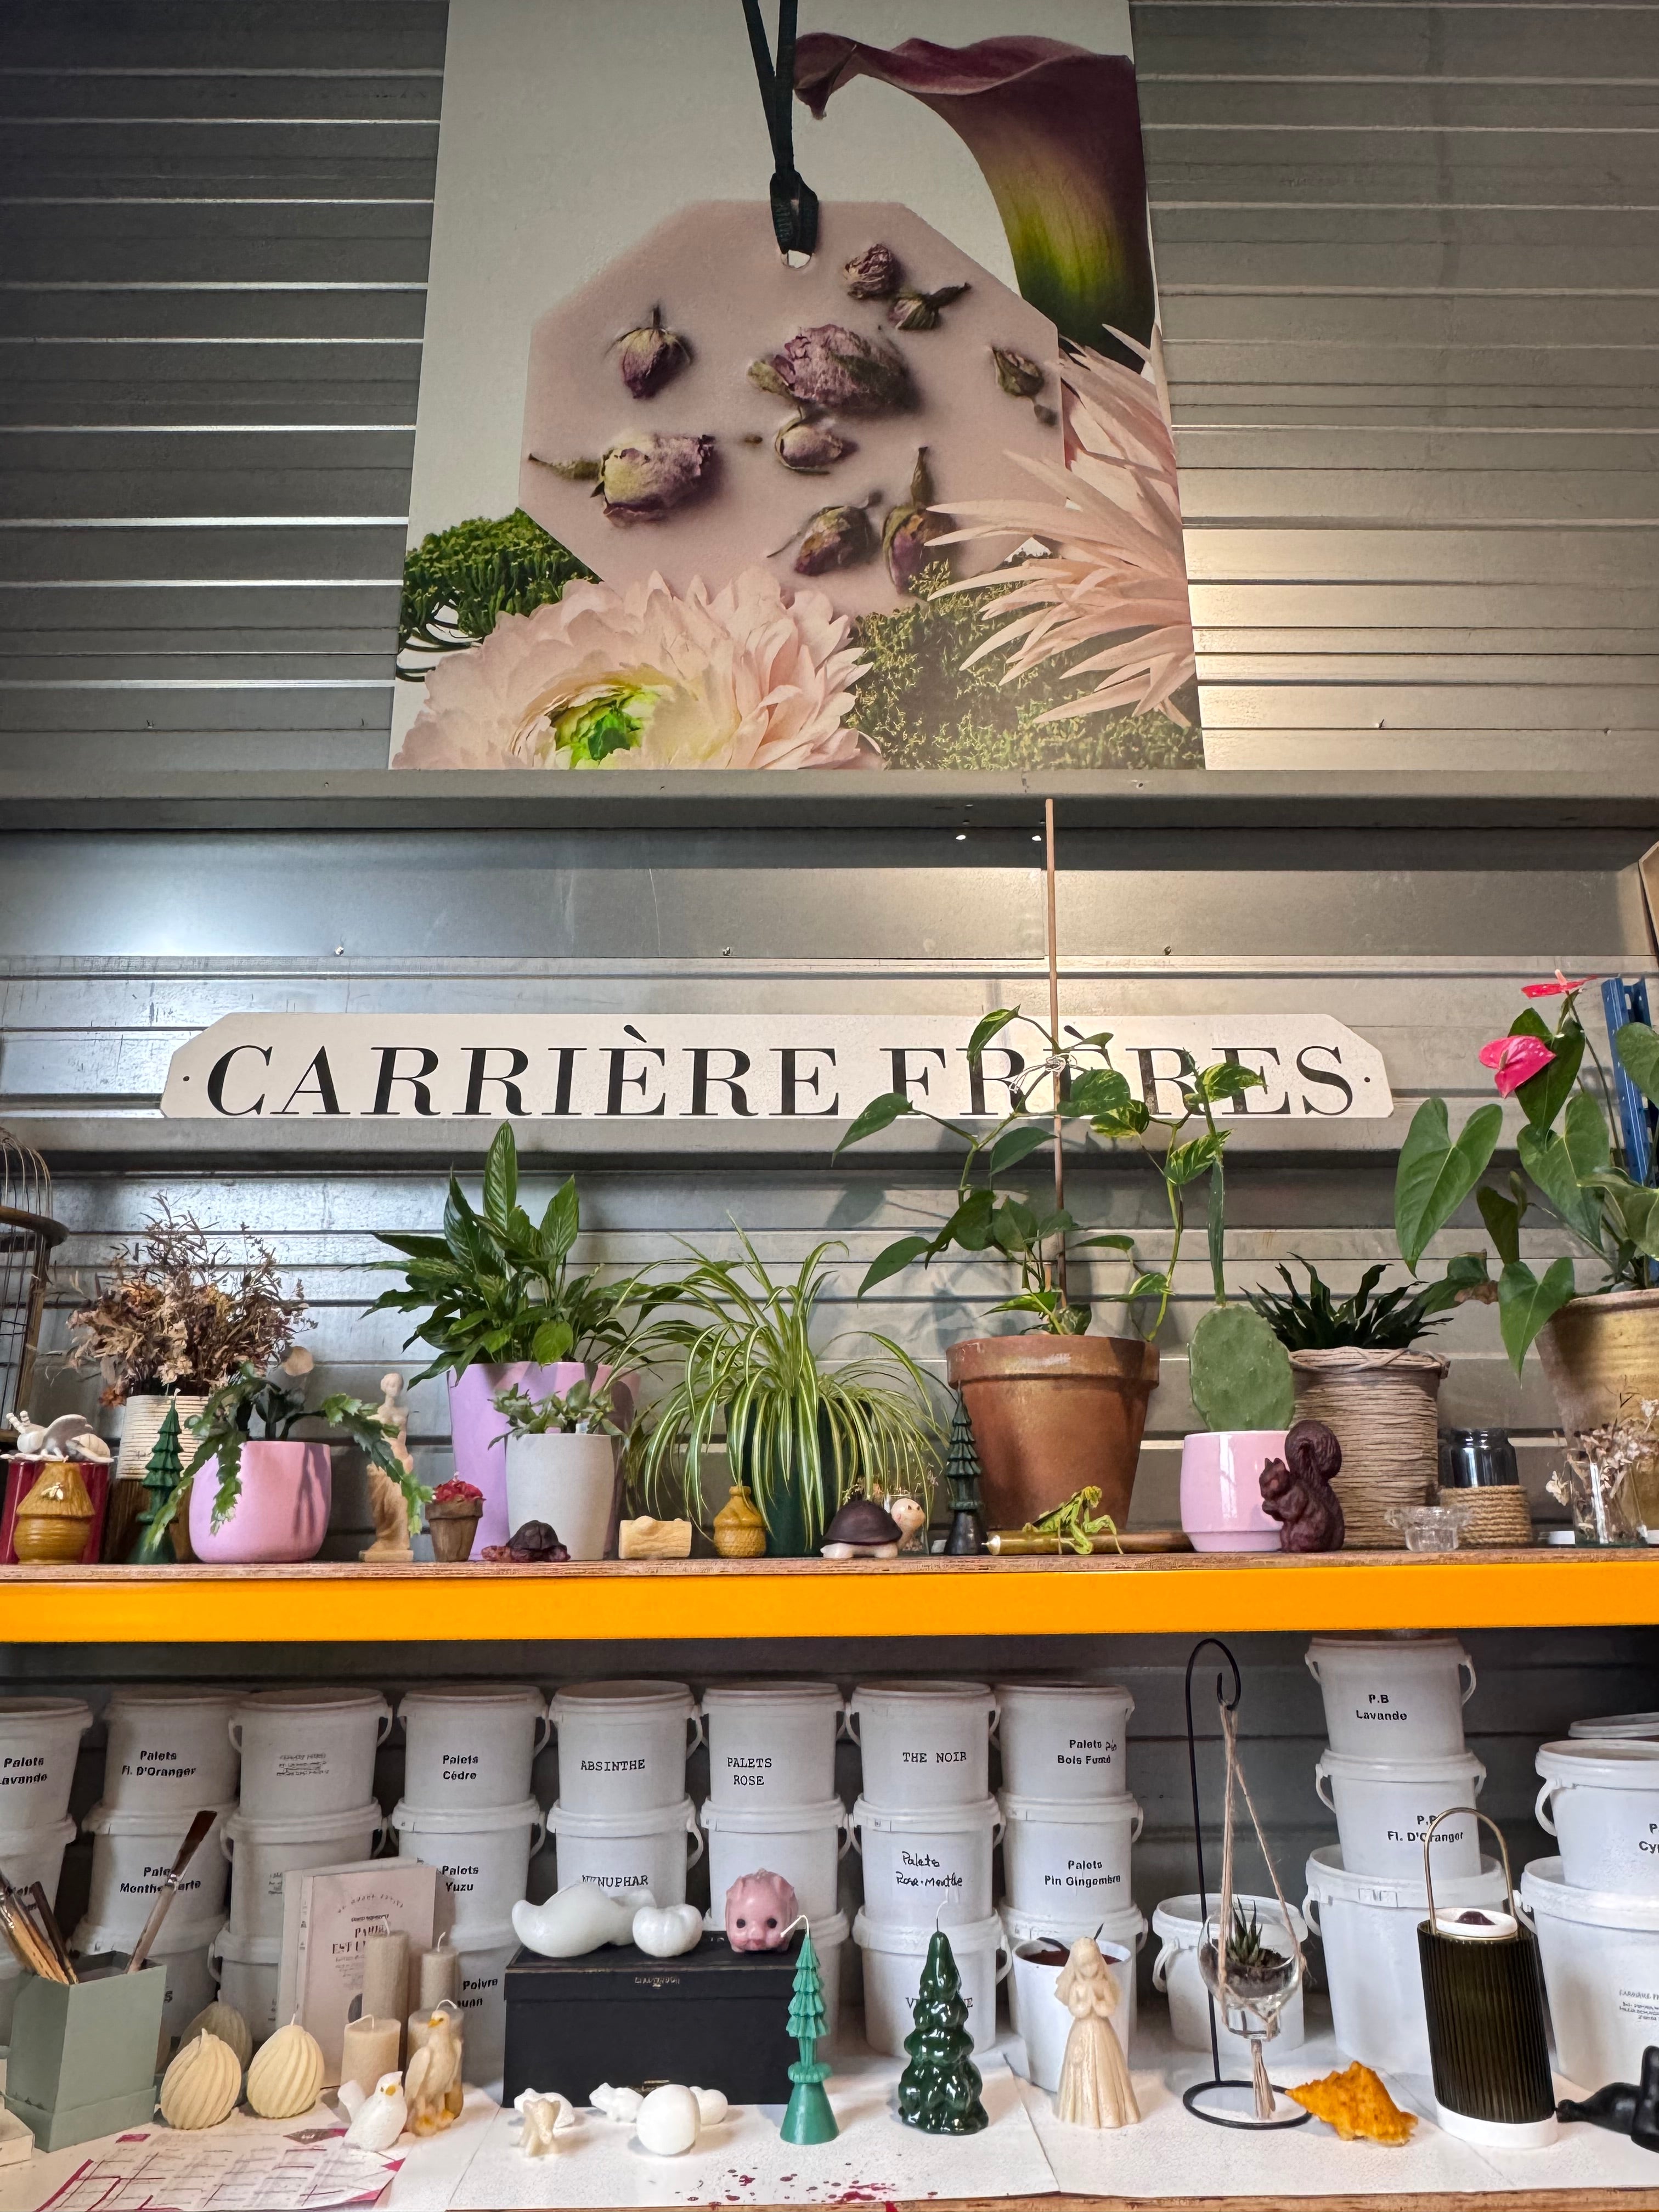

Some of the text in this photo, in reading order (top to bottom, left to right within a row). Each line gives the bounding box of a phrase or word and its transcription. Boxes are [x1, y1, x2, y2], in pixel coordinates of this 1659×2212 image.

[206, 1024, 839, 1116] CARRIÈRE
[1368, 1694, 1389, 1703] P.B
[1356, 1709, 1408, 1720] Lavande
[443, 1754, 479, 1764] Palets
[727, 1757, 772, 1768] PALETS
[902, 1751, 967, 1763] THE NOIR
[1057, 1755, 1082, 1764] Bois
[580, 1759, 645, 1771] ABSINTHE
[136, 1766, 196, 1778] D'Oranger
[733, 1775, 765, 1786] ROSE
[1387, 1831, 1403, 1841] Fl.
[1045, 1875, 1062, 1886] Pin
[445, 1881, 474, 1892] Yuzu
[463, 1978, 498, 1991] Poivre
